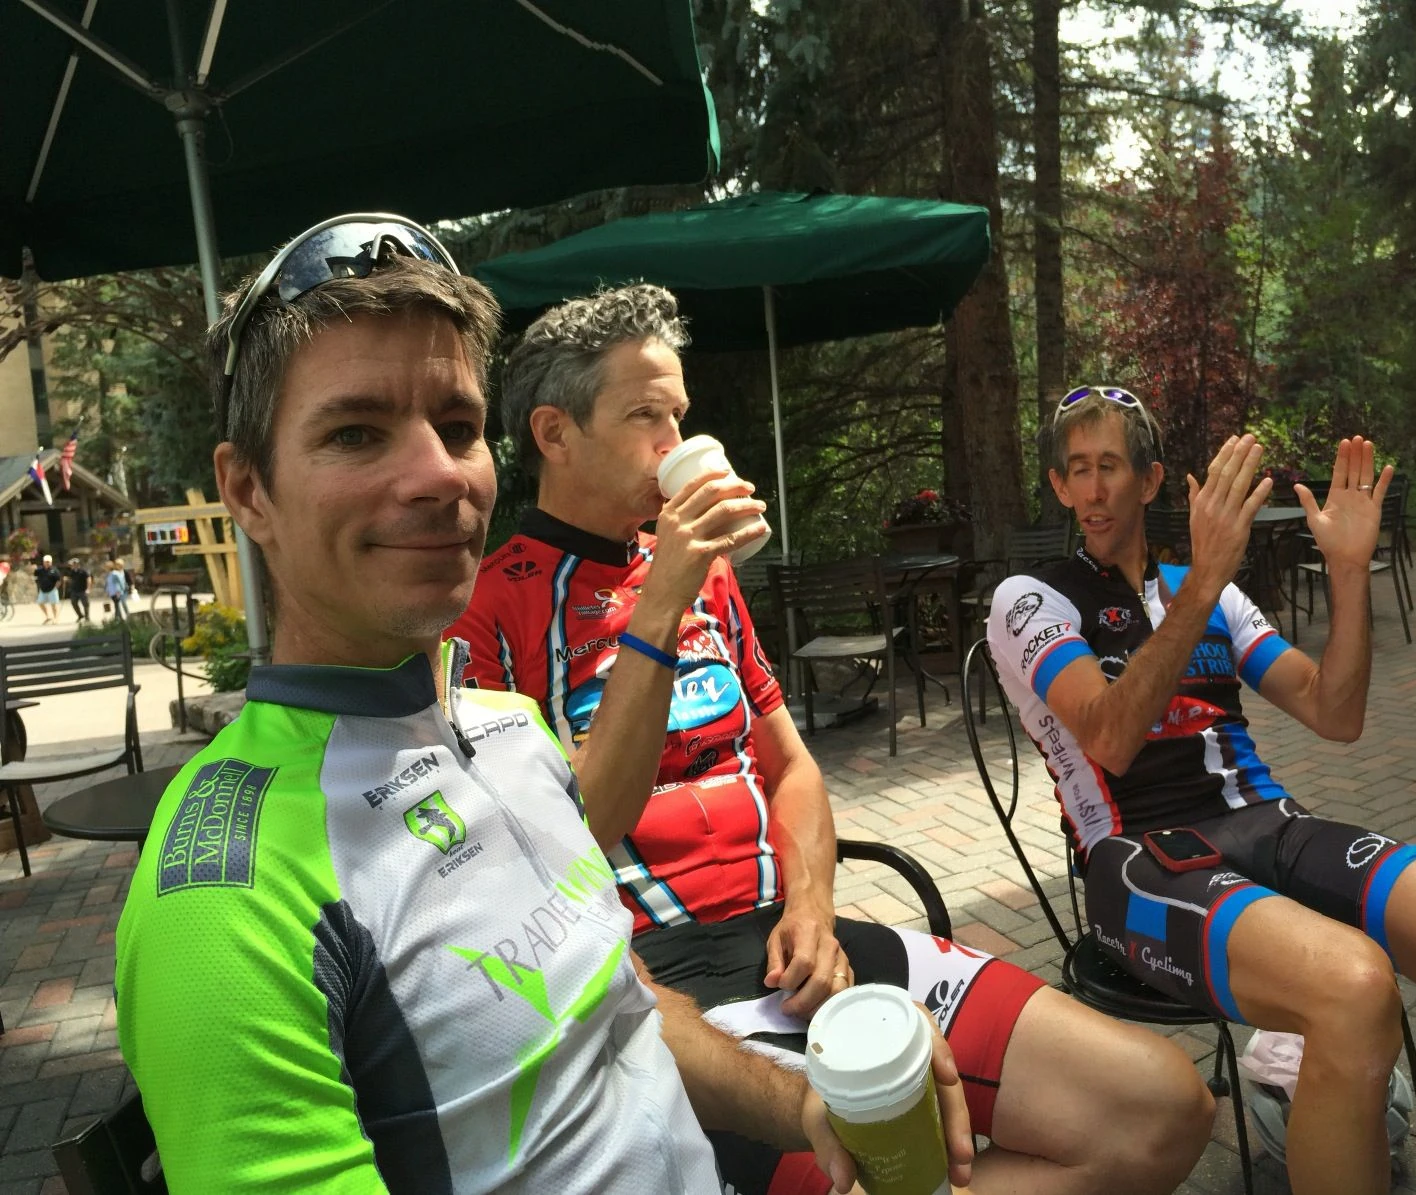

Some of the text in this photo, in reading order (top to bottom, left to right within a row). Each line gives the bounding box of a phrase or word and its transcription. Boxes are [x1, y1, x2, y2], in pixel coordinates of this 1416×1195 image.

[362, 752, 440, 809] ERIKSEN
[164, 776, 219, 870] Burns &
[195, 767, 246, 866] McDonnell
[234, 811, 250, 841] SINCE
[437, 842, 485, 879] ERIKSEN
